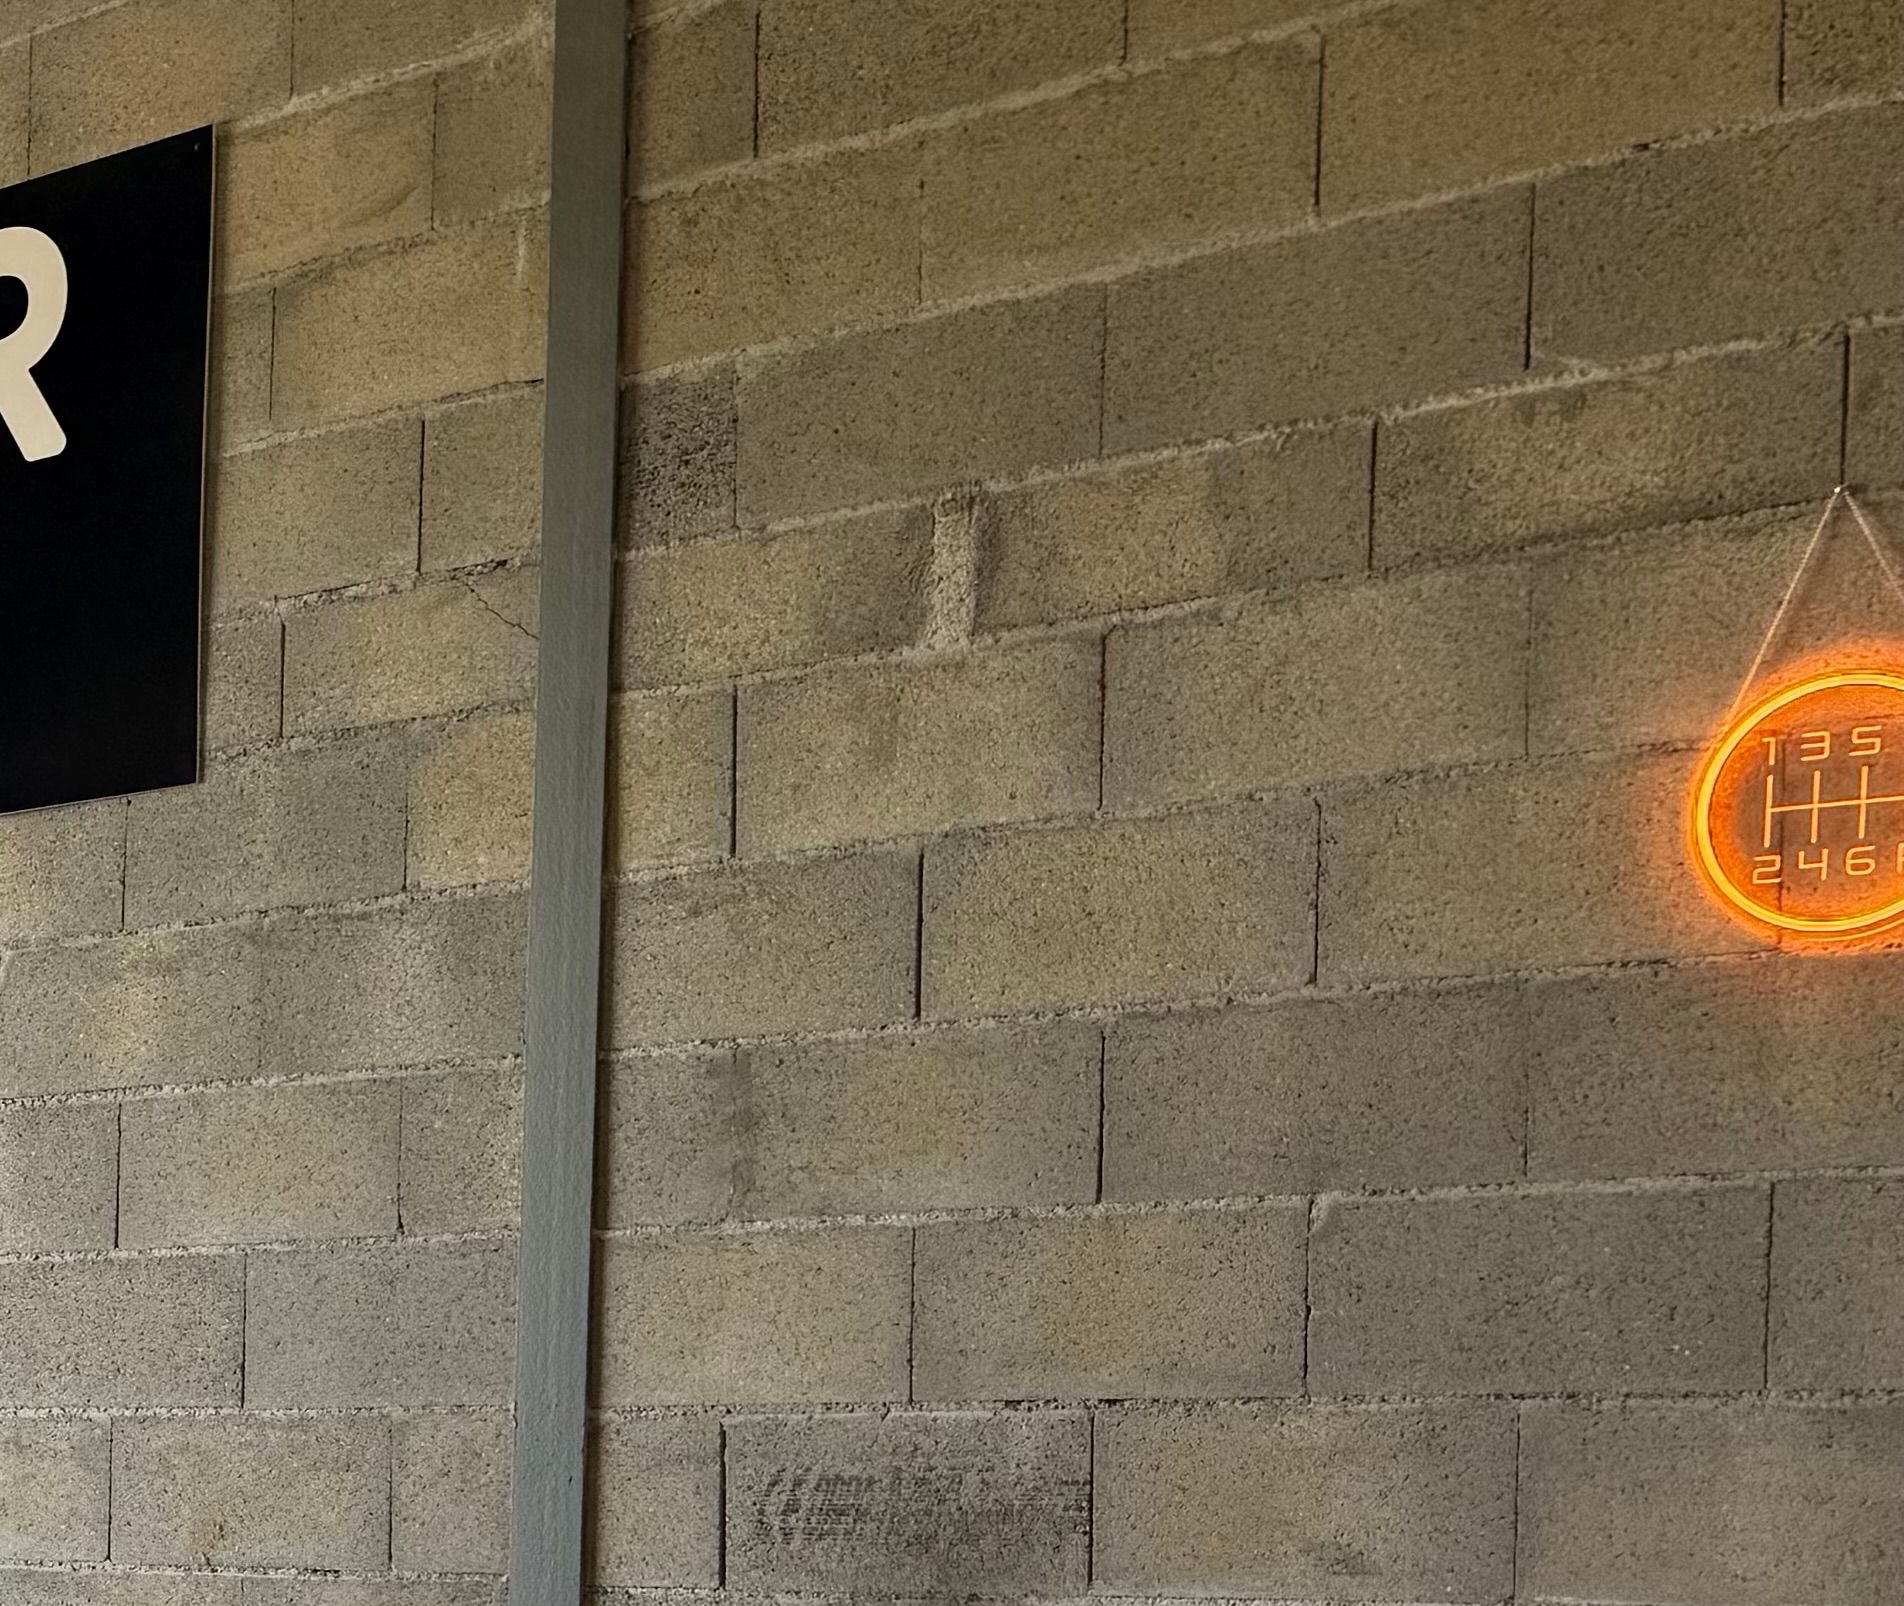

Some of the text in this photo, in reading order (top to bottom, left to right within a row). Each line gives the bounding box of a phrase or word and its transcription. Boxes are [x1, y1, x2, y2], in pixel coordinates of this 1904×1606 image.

[1762, 725, 1882, 766] 1 3 5
[1751, 854, 1782, 885] 2
[1798, 848, 1829, 881] 4
[1845, 845, 1877, 876] 6
